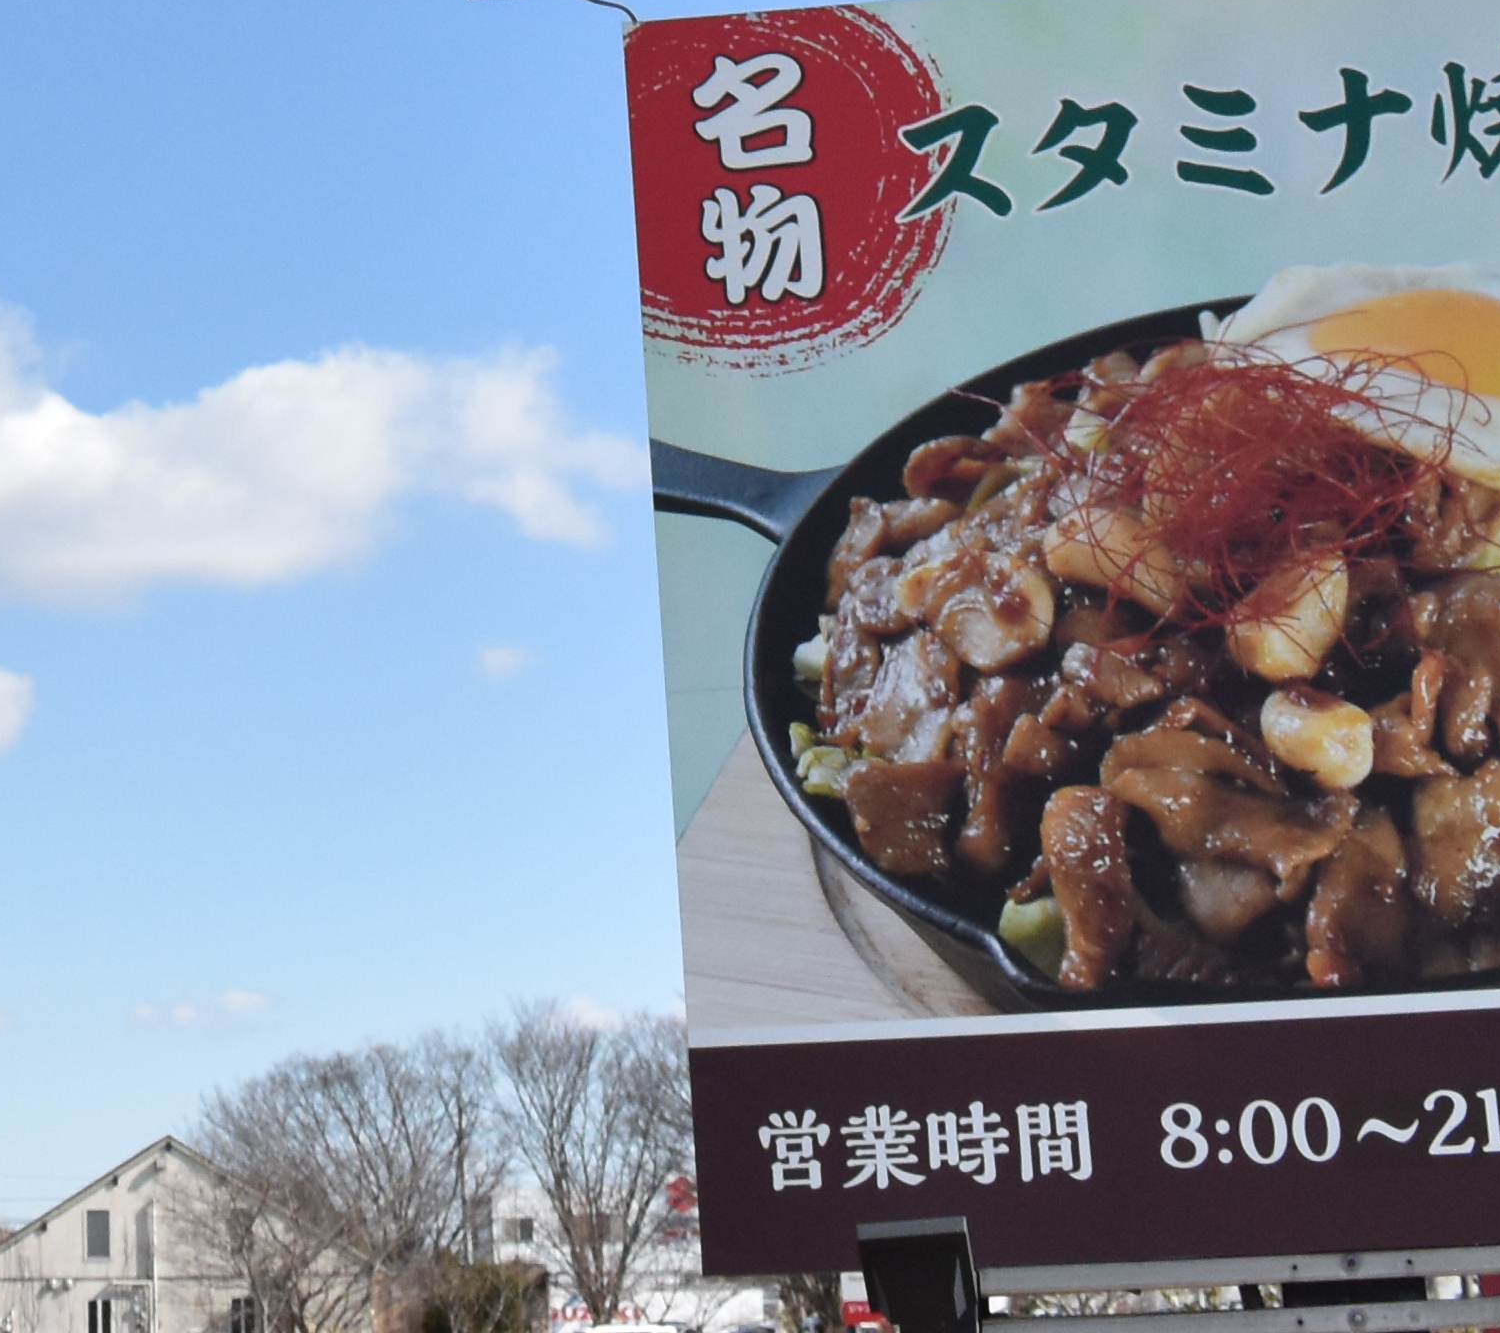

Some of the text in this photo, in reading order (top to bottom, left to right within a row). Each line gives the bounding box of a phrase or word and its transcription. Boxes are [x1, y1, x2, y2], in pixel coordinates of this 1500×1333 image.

[690, 51, 826, 306] 名物
[757, 1097, 1095, 1193] 営業時間
